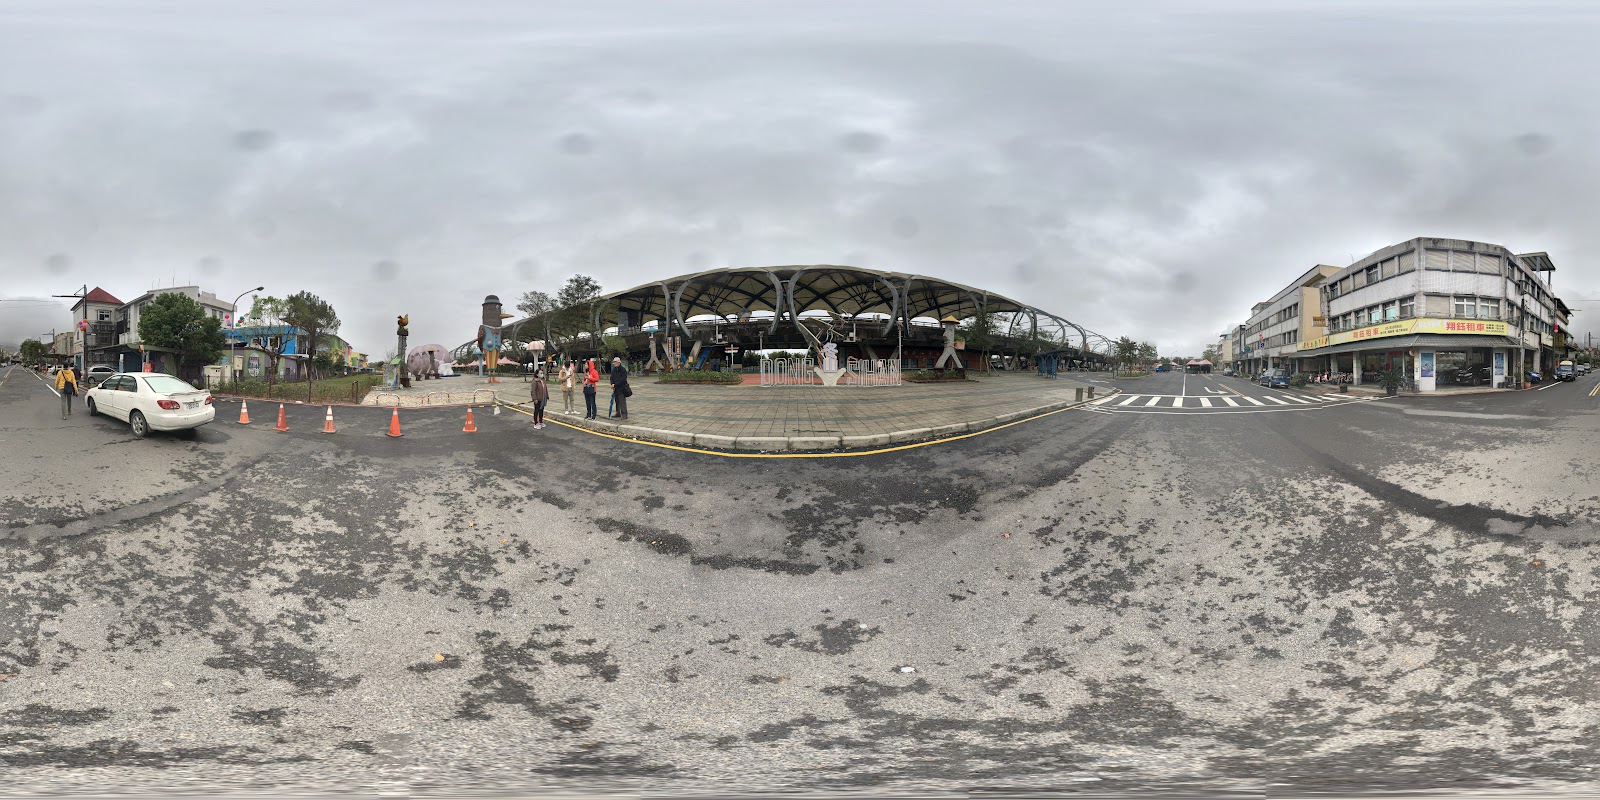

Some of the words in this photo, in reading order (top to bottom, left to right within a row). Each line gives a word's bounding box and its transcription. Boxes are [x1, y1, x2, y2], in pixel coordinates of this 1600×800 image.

[1446, 321, 1485, 332] 翔鈺租車
[760, 357, 815, 387] DONG
[847, 355, 902, 387] SHAN
